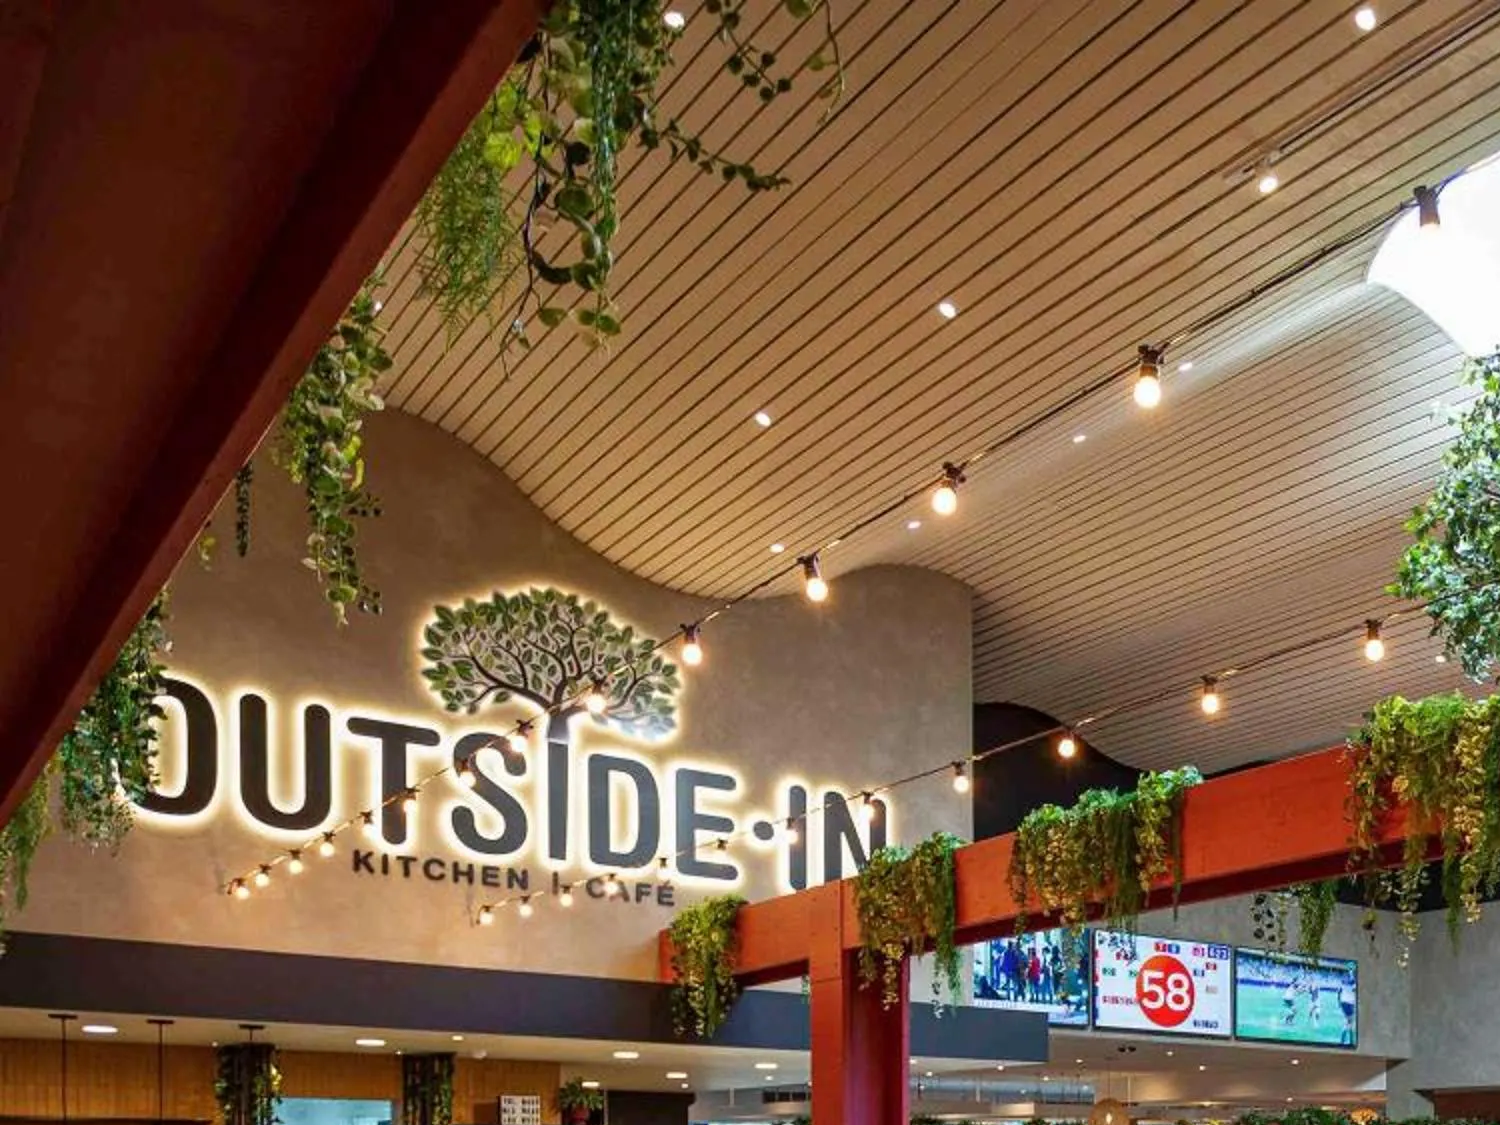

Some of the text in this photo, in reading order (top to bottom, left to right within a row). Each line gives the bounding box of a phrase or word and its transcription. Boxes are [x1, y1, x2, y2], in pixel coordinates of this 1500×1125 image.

[352, 849, 675, 907] KITCHEN CAFÉ
[1142, 969, 1191, 1011] 58
